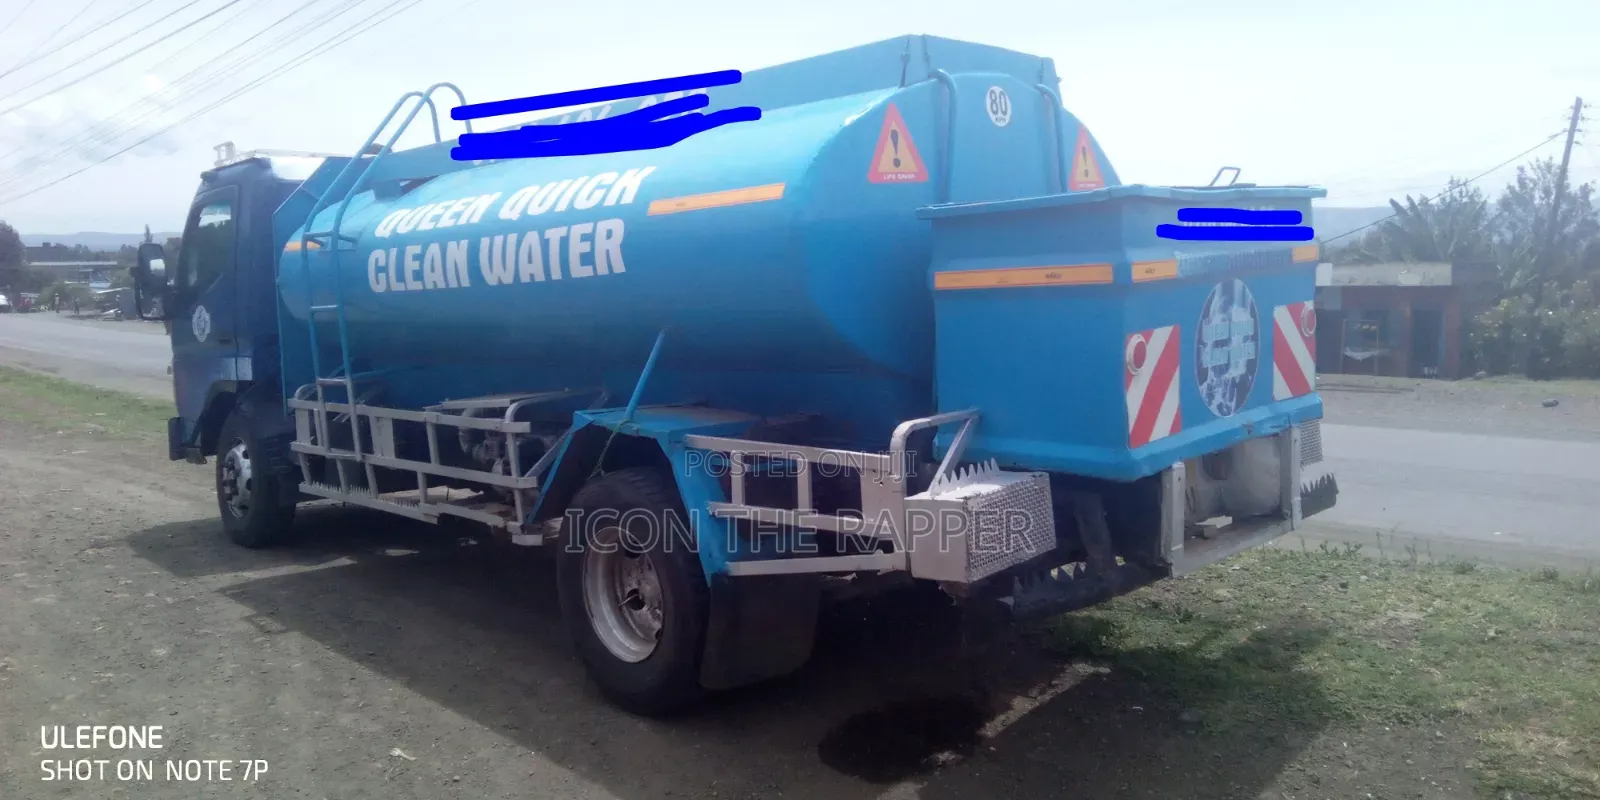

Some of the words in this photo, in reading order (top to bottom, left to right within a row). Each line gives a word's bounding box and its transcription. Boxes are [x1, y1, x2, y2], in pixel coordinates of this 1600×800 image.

[989, 89, 1008, 116] 80
[376, 193, 499, 238] QUEEN
[500, 167, 656, 220] QUICK
[369, 240, 470, 293] CLEAN
[479, 218, 626, 286] WATER
